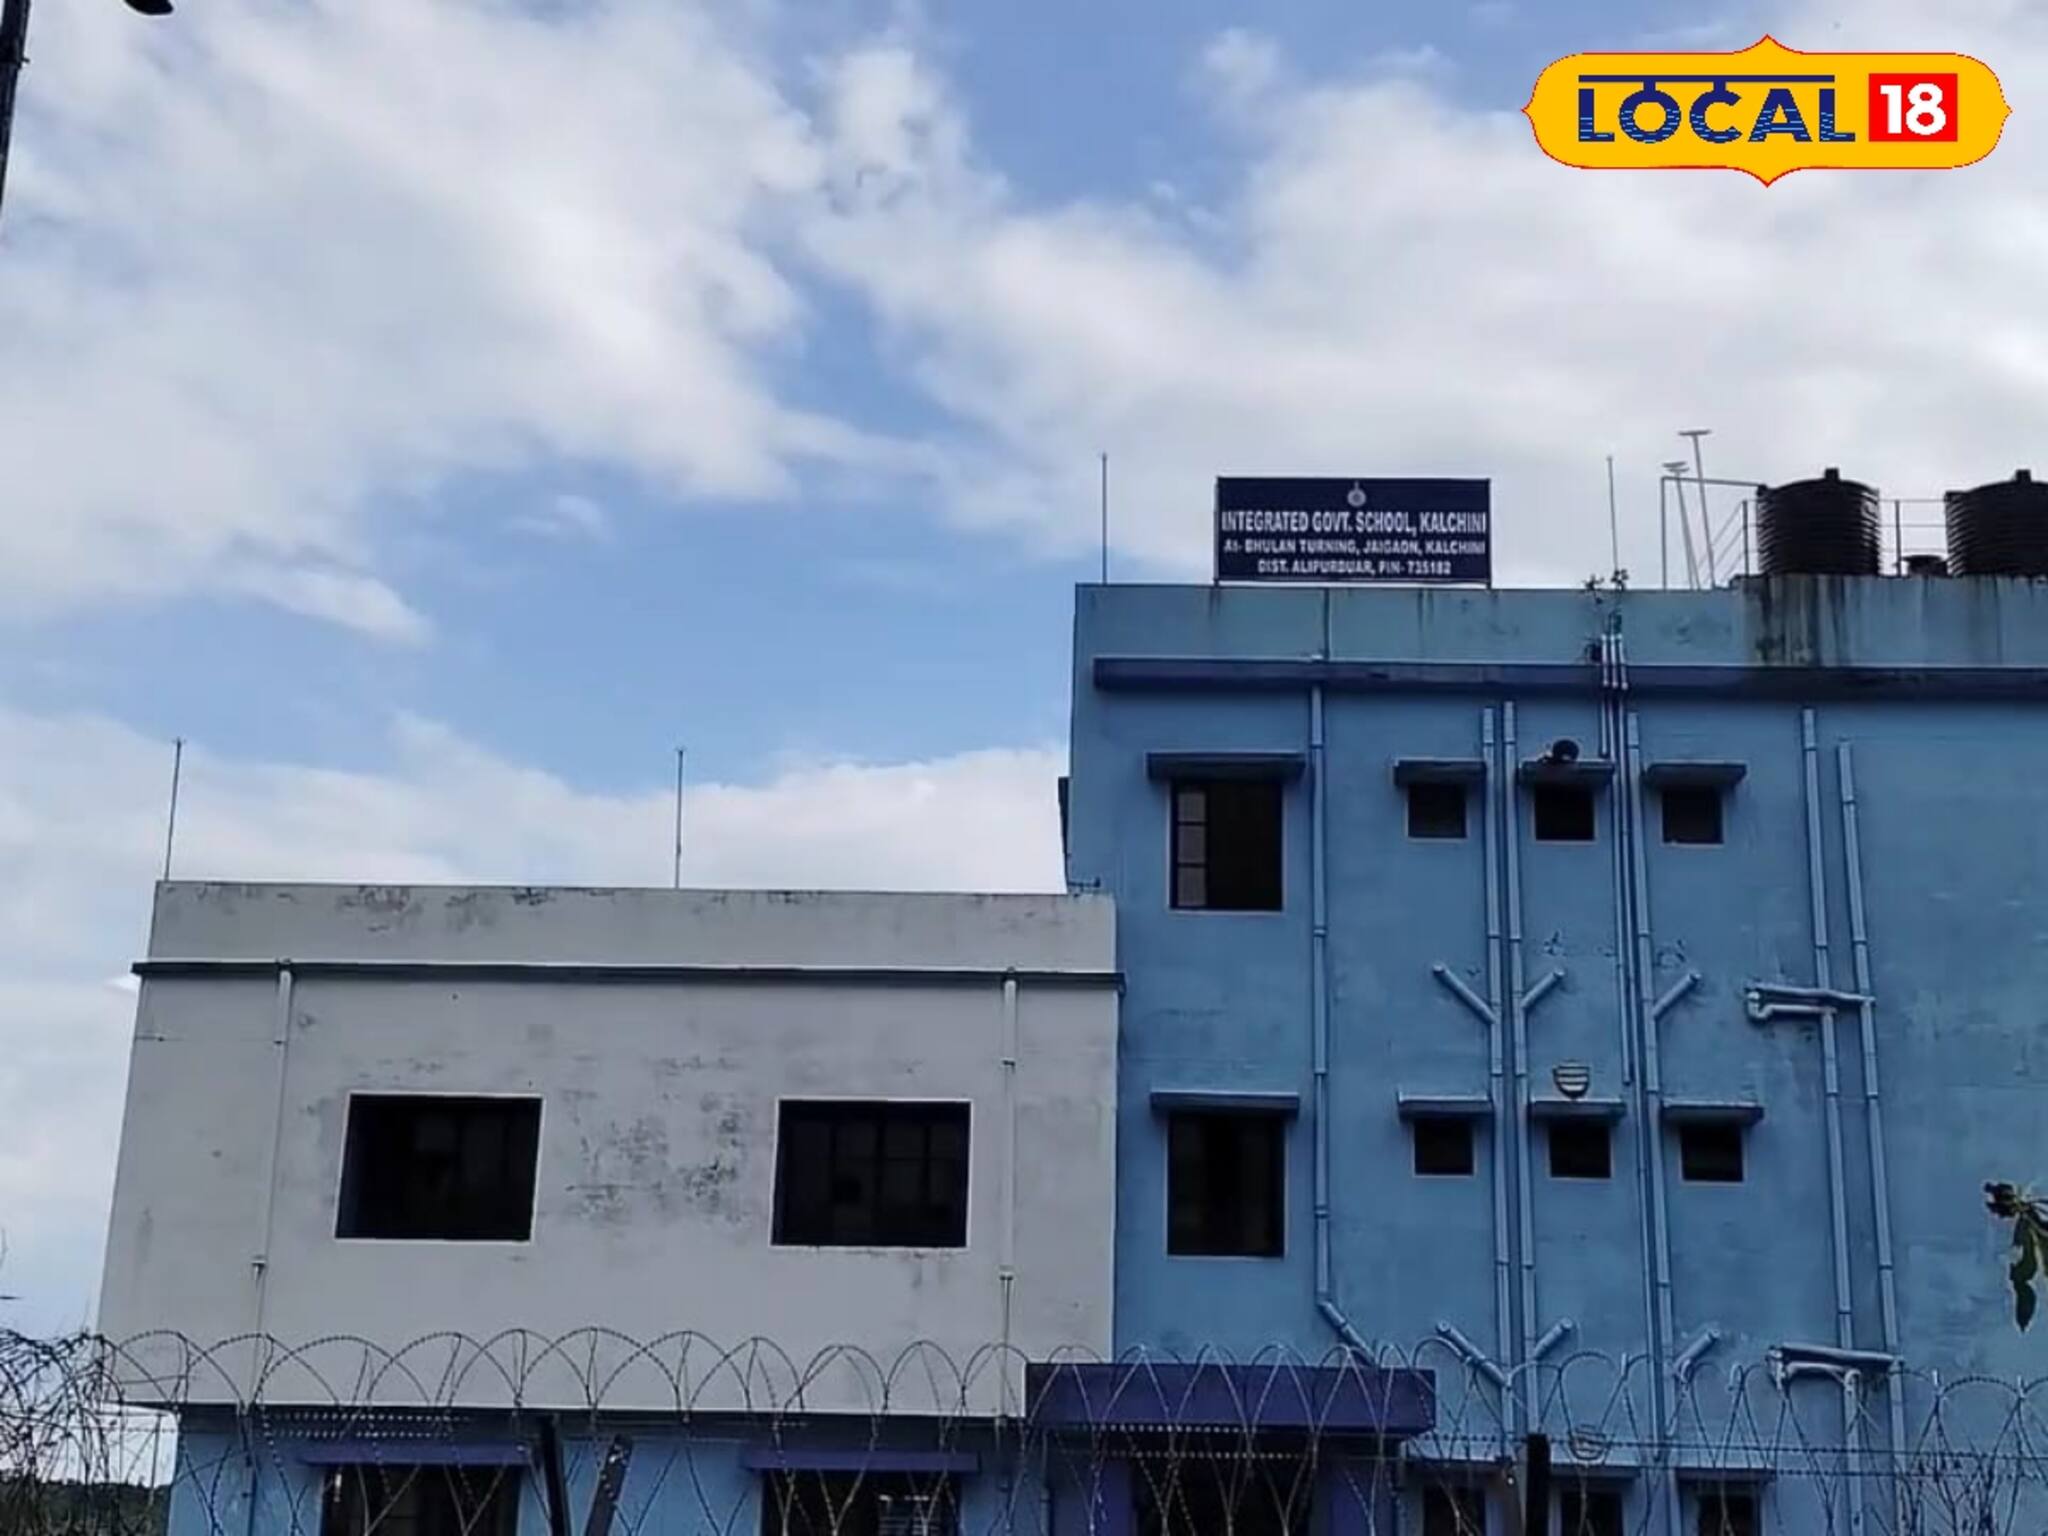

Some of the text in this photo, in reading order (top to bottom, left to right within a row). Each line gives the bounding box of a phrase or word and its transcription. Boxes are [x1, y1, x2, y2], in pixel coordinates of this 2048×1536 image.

[1222, 511, 1486, 537] INTEGRATED GOVT. SCHOOL, KALCHINI
[1425, 541, 1485, 553] KALCHINI
